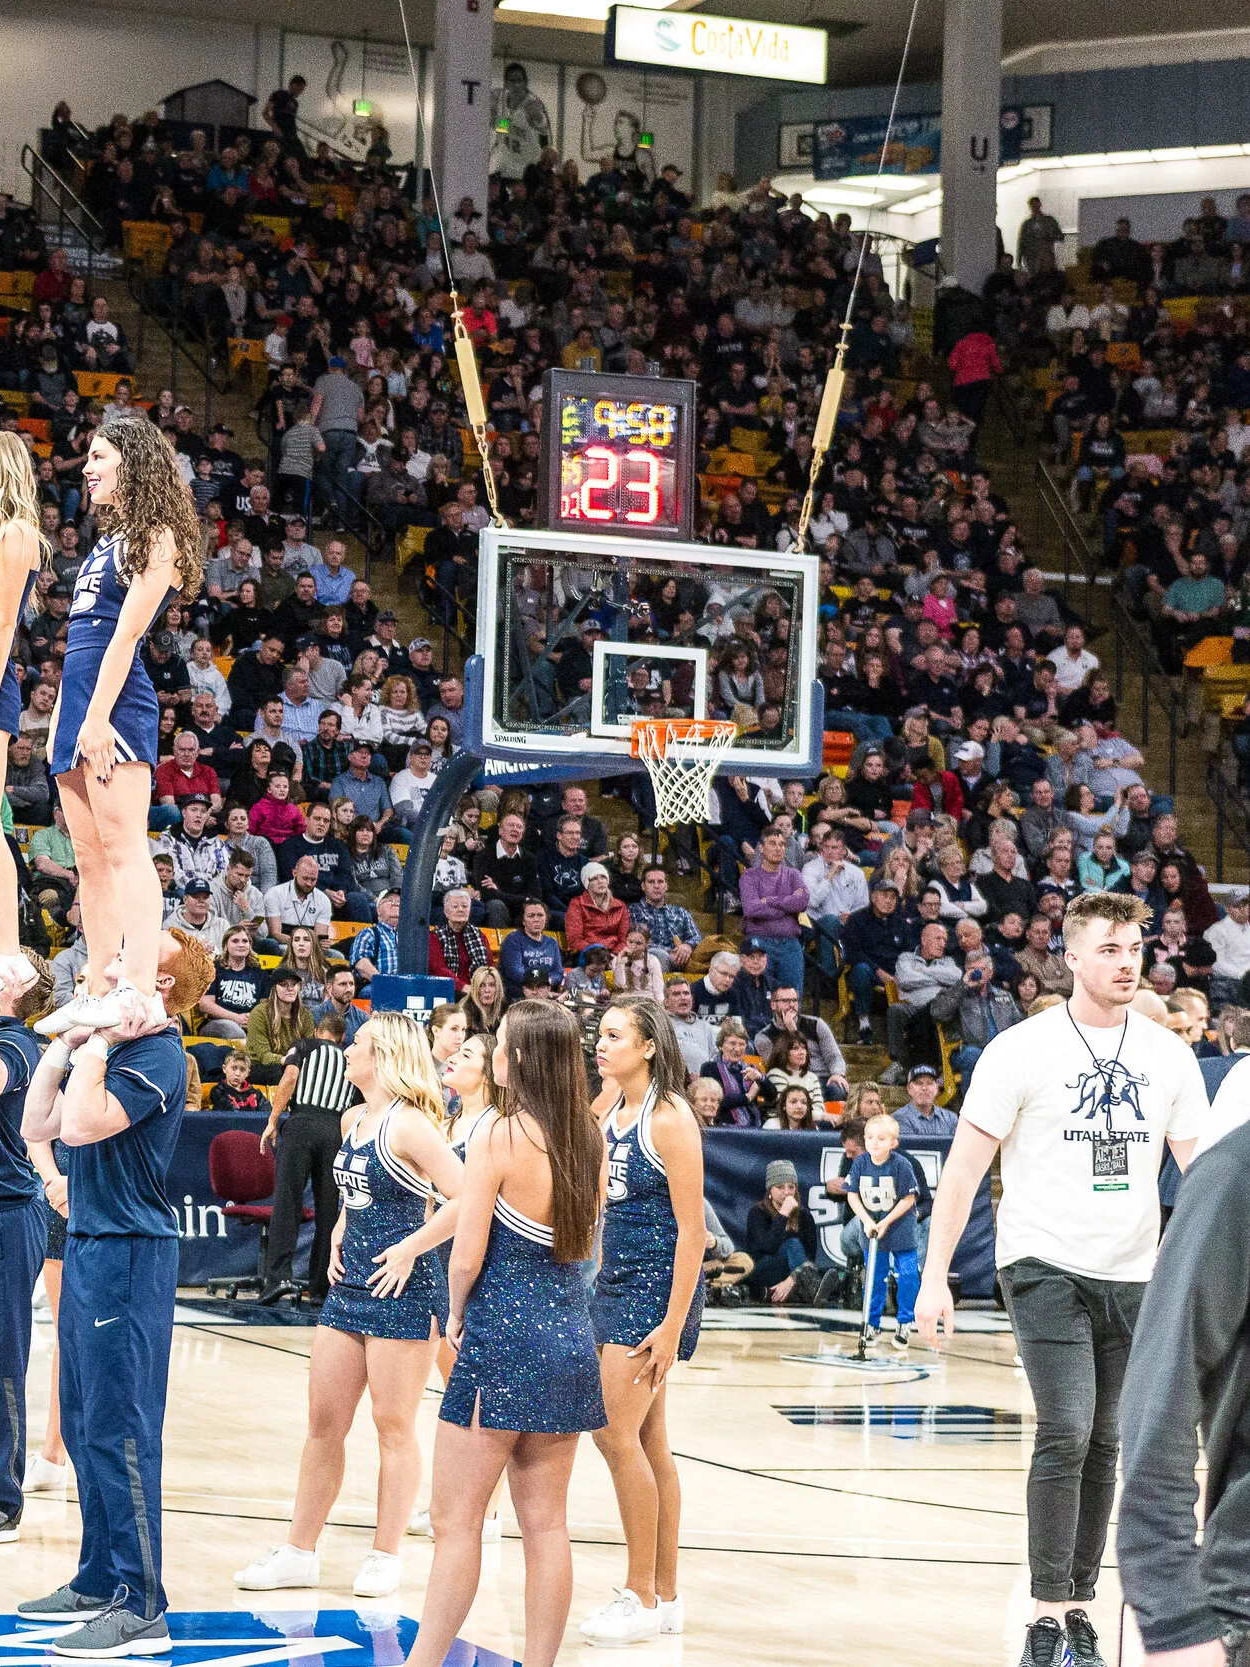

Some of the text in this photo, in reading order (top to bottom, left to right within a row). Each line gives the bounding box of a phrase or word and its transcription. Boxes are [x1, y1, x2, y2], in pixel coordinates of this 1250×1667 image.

[461, 79, 481, 105] T
[970, 136, 988, 161] U
[593, 400, 672, 447] 9:58
[580, 446, 660, 524] 23
[494, 734, 527, 744] SPALDING
[1063, 1130, 1102, 1142] UTAH
[1108, 1131, 1150, 1143] STATE
